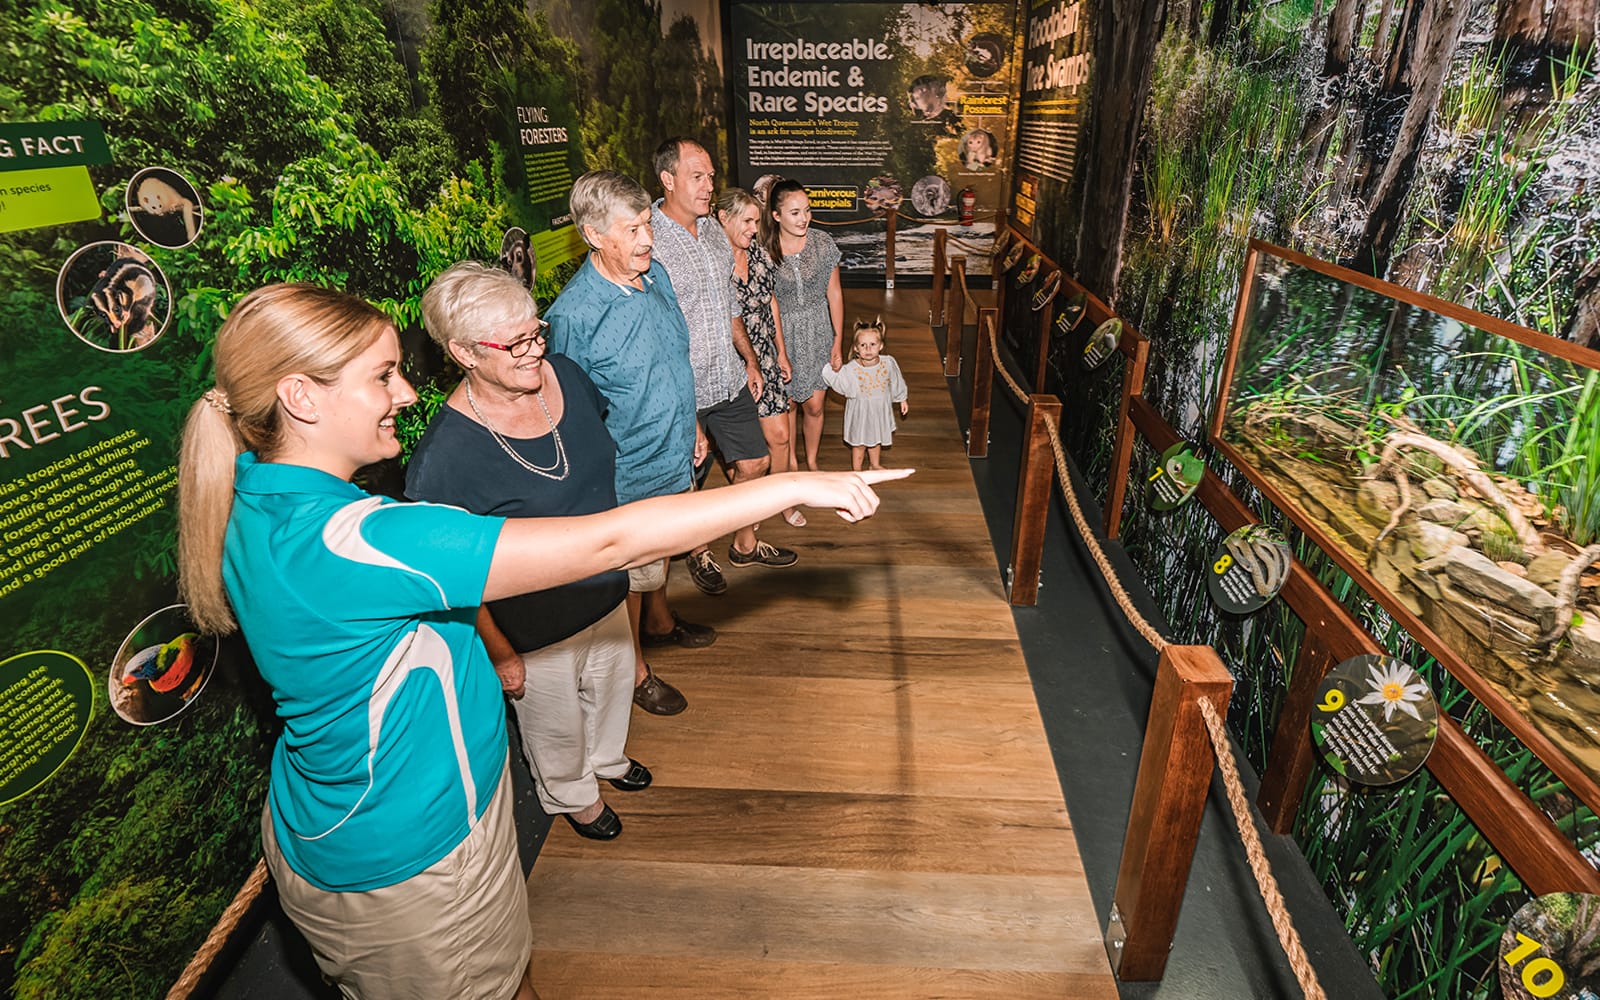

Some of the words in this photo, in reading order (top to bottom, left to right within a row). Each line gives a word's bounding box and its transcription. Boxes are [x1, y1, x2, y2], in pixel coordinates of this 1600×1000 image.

[1028, 0, 1080, 50] Floodplain
[746, 38, 894, 65] Irreplaceable,
[747, 65, 841, 87] Endemic
[847, 65, 865, 87] &
[1026, 60, 1045, 92] Tree
[1045, 51, 1091, 95] Swamps
[749, 91, 798, 113] Rare
[804, 91, 889, 117] Species
[960, 95, 1007, 105] Rainforest
[963, 105, 1003, 115] Possums
[517, 106, 549, 124] FLYING
[749, 119, 769, 127] North
[818, 119, 832, 127] Wet
[833, 119, 859, 128] Tropics
[20, 135, 84, 156] FACT
[520, 127, 568, 146] FORESTERS
[10, 183, 52, 196] species
[0, 386, 111, 458] REES
[26, 453, 77, 482] tropical
[77, 428, 137, 460] rainforests
[30, 478, 61, 500] your
[61, 461, 96, 482] head.
[95, 446, 129, 466] While
[128, 437, 151, 454] you
[47, 483, 88, 506] above,
[88, 458, 136, 486] spotting
[4, 518, 47, 543] forest
[45, 502, 76, 522] floor
[77, 478, 124, 506] through
[124, 468, 144, 482] the
[7, 533, 53, 557] tangle
[52, 520, 67, 534] of
[66, 494, 120, 527] branches
[121, 482, 143, 499] and
[142, 470, 168, 487] vines
[168, 464, 177, 474] is
[23, 550, 48, 565] life
[46, 542, 62, 554] in
[61, 530, 84, 545] the
[83, 513, 113, 533] trees
[113, 502, 136, 520] you
[135, 488, 155, 506] will
[155, 476, 179, 495] need
[23, 573, 33, 583] a
[33, 551, 69, 579] good
[68, 540, 93, 560] pair
[93, 529, 107, 543] of
[106, 497, 165, 536] binoculars!
[1213, 554, 1233, 575] 8
[28, 665, 48, 679] the
[8, 703, 27, 718] the
[27, 678, 64, 705] sounds
[14, 676, 49, 701] comes
[1316, 688, 1345, 712] 9
[9, 703, 43, 730] calling
[42, 688, 63, 706] and
[50, 702, 77, 724] move
[24, 740, 42, 755] the
[42, 712, 76, 742] canopy
[38, 742, 54, 756] for
[1503, 931, 1565, 998] 10
